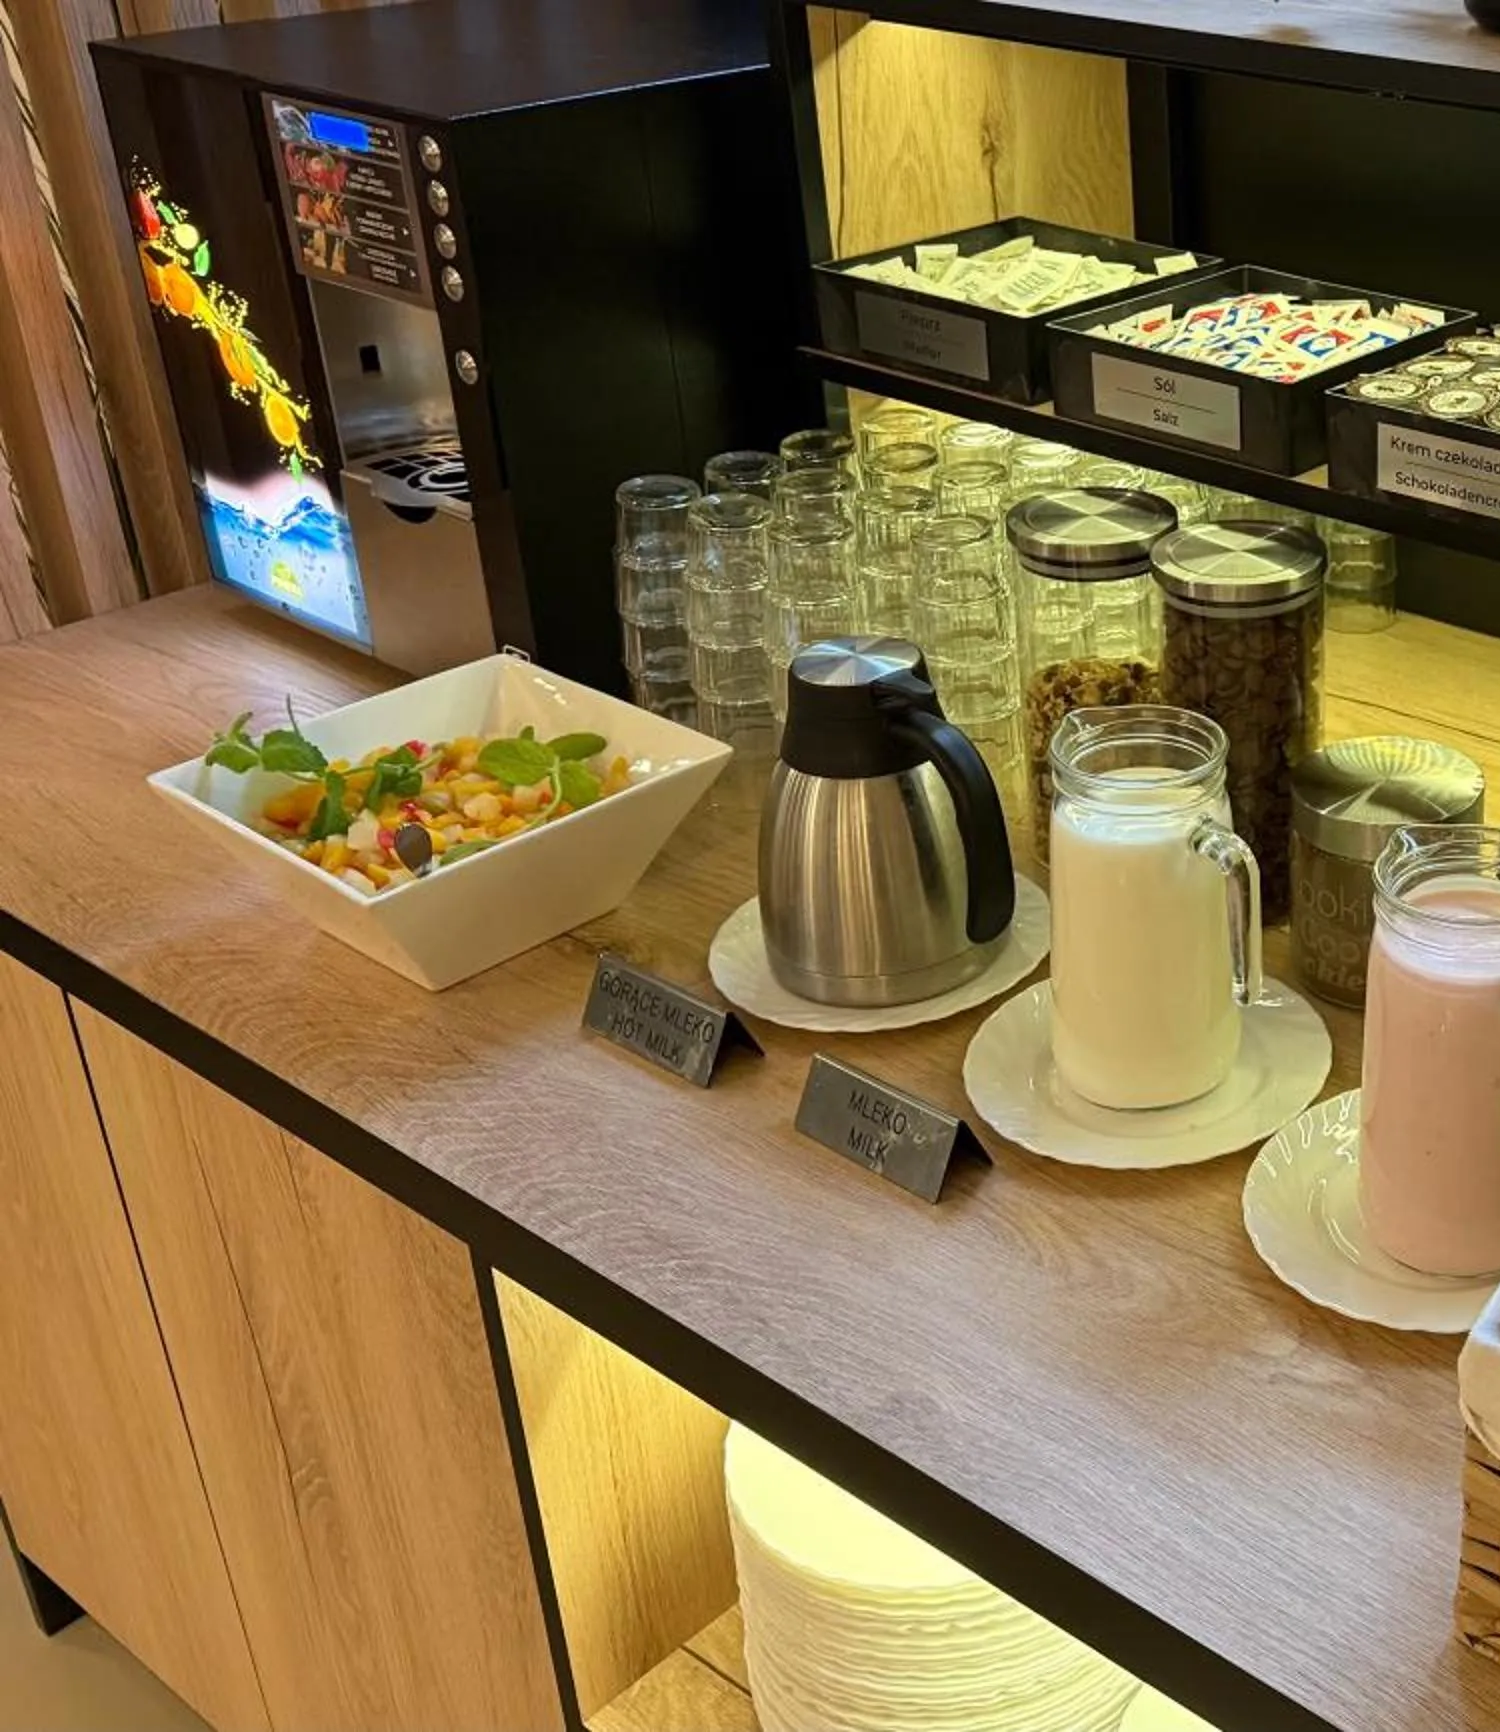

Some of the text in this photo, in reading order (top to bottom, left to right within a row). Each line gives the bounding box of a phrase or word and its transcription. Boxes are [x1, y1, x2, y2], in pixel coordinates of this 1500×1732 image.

[1153, 376, 1176, 394] Sól
[1153, 409, 1179, 426] Salz
[1390, 434, 1431, 457] Krem
[600, 971, 716, 1043] GORĄCE MLEKO
[611, 1012, 683, 1065] HOT MILK
[848, 1089, 907, 1135] MLEKO
[847, 1126, 889, 1165] MILK
